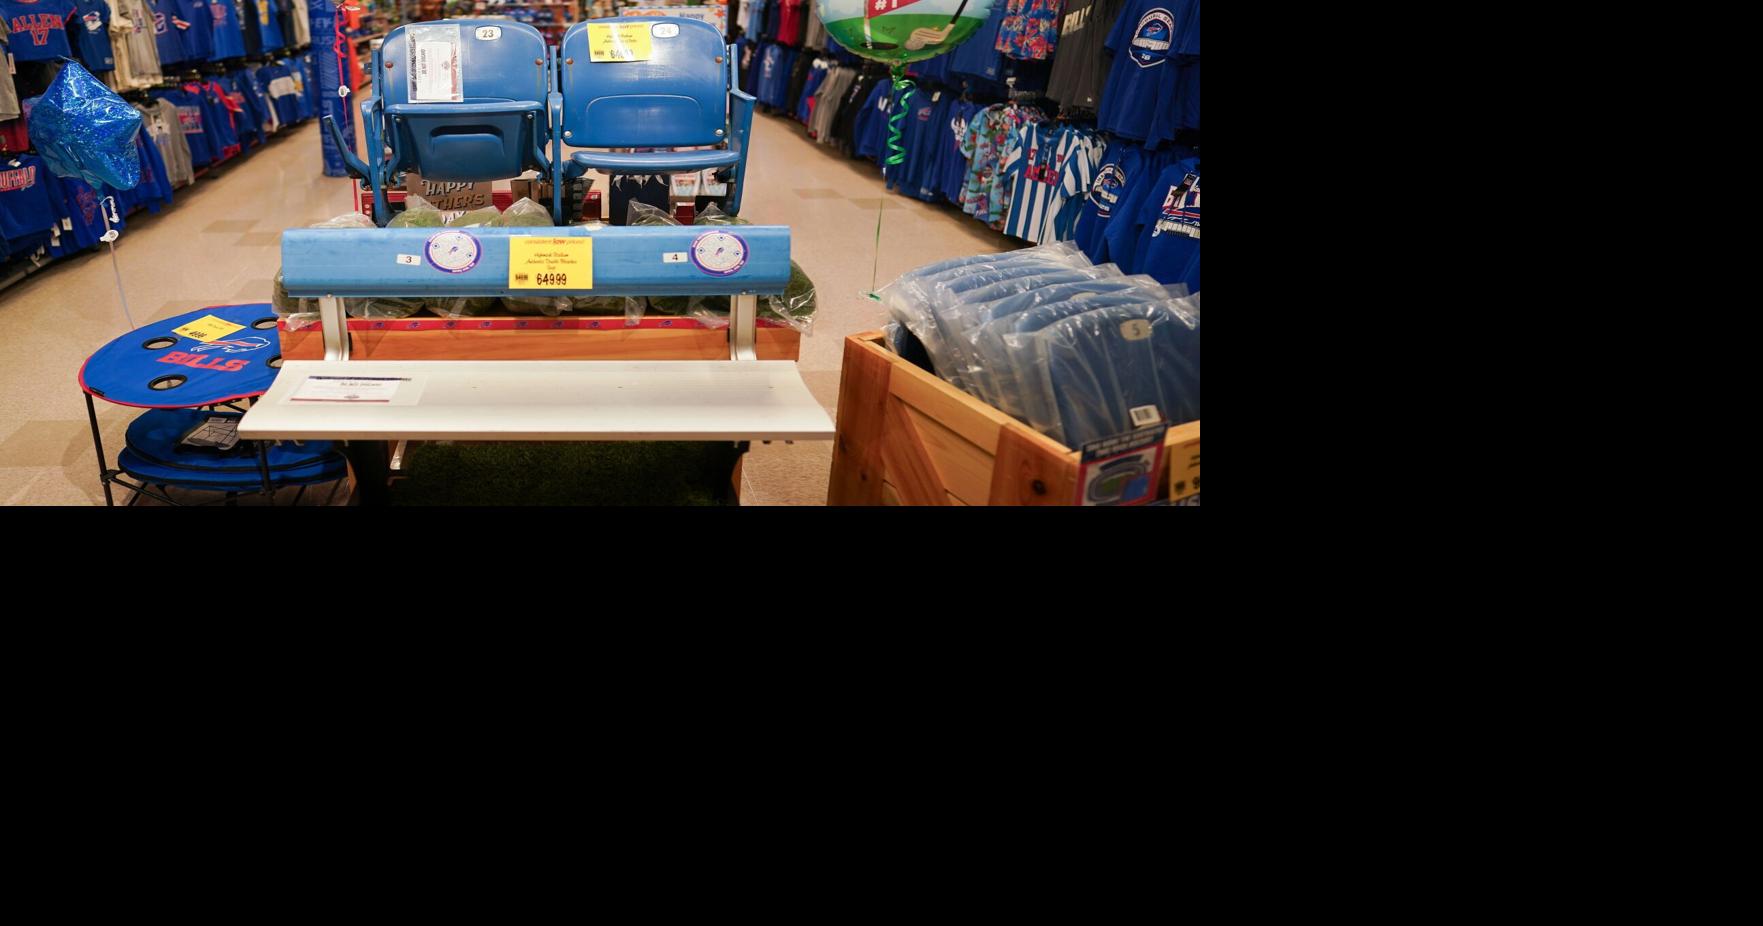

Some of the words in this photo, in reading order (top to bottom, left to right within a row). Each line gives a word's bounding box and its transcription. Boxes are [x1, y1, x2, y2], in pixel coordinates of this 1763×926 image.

[12, 13, 65, 33] ALLEN
[30, 28, 50, 46] 17
[482, 29, 494, 38] 23
[421, 180, 476, 197] HAPPY
[406, 255, 412, 263] 3
[536, 273, 567, 285] 64999
[1132, 322, 1141, 333] 5
[156, 351, 250, 372] BILLS
